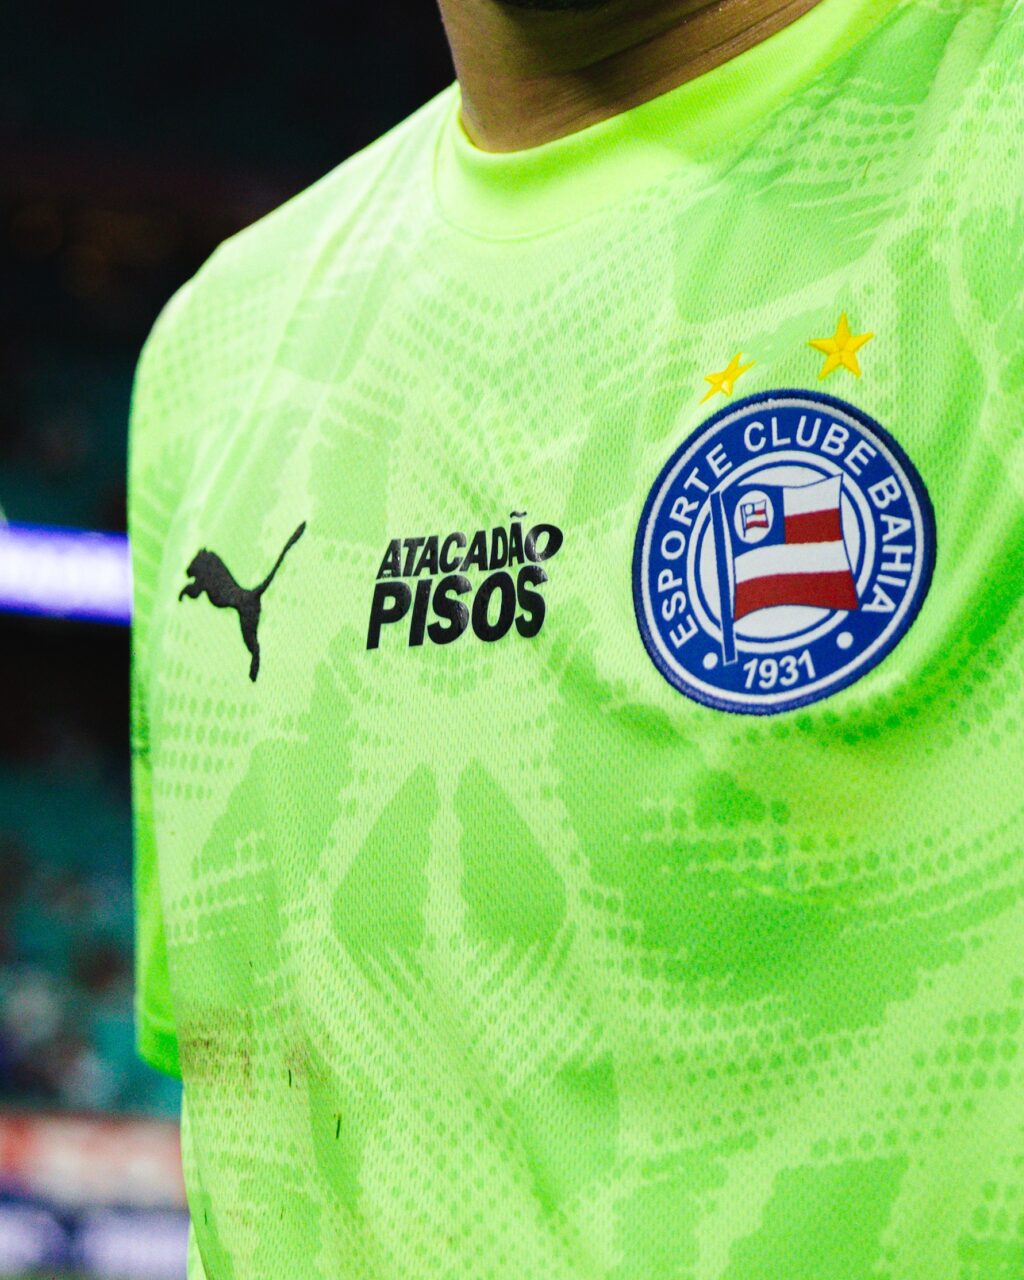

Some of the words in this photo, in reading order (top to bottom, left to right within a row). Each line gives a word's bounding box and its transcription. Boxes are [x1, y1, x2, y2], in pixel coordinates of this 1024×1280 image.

[376, 510, 563, 580] ATACADÃO
[657, 442, 733, 650] ESPORTE
[743, 415, 877, 476] CLUBE
[861, 475, 913, 614] BAHIA
[366, 565, 548, 650] PISOS
[742, 650, 817, 690] 1931
